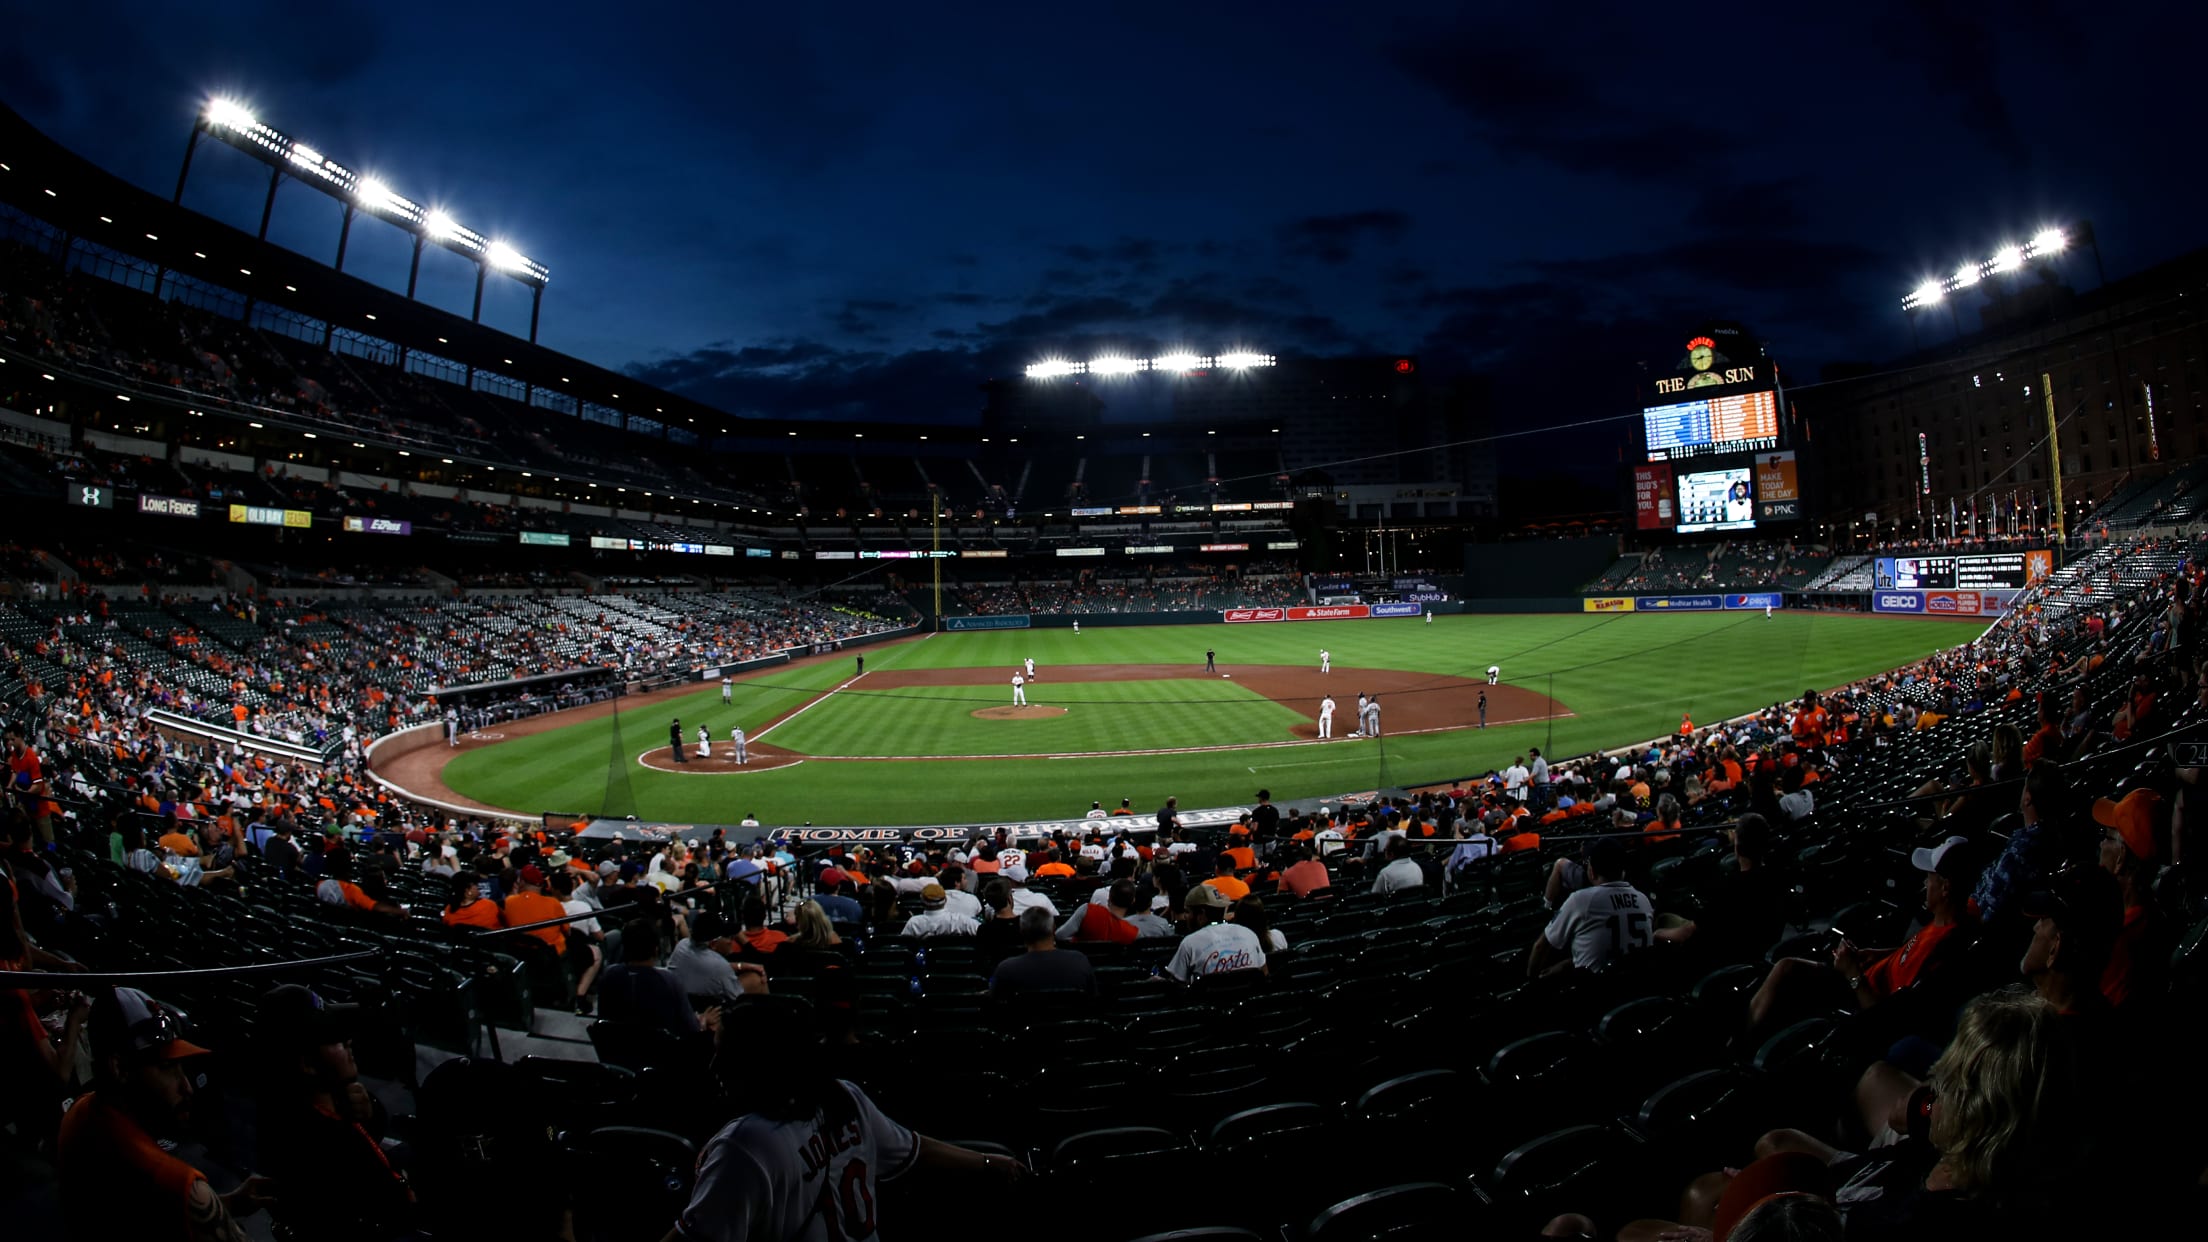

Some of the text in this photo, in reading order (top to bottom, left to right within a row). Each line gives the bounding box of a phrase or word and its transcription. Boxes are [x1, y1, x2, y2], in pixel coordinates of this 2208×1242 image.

[1686, 336, 1716, 352] ORIOLES
[1656, 366, 1755, 395] THE SUN
[1636, 472, 1652, 480] THIS
[1760, 472, 1782, 481] MAKE
[1636, 481, 1658, 491] BUD'S
[1760, 481, 1785, 491] TODAY
[1637, 491, 1652, 500] FOR
[1761, 488, 1793, 499] THE DAY
[142, 496, 198, 516] LONG FENCE
[1637, 501, 1655, 510] YOU.
[1774, 504, 1795, 515] PNC
[248, 508, 265, 523] OLD
[266, 509, 283, 524] BAY
[1878, 575, 1892, 588] utz
[1410, 593, 1440, 602] StubHub
[1749, 596, 1771, 606] pepsi
[1881, 595, 1917, 608] GEICO
[1376, 606, 1411, 614] Southwest
[780, 828, 901, 841] HOME
[913, 827, 969, 840] OF
[1003, 854, 1021, 868] 22
[1610, 894, 1639, 911] INGE
[1606, 913, 1647, 951] 15
[1203, 949, 1252, 976] Costa
[798, 1121, 862, 1182] JONES
